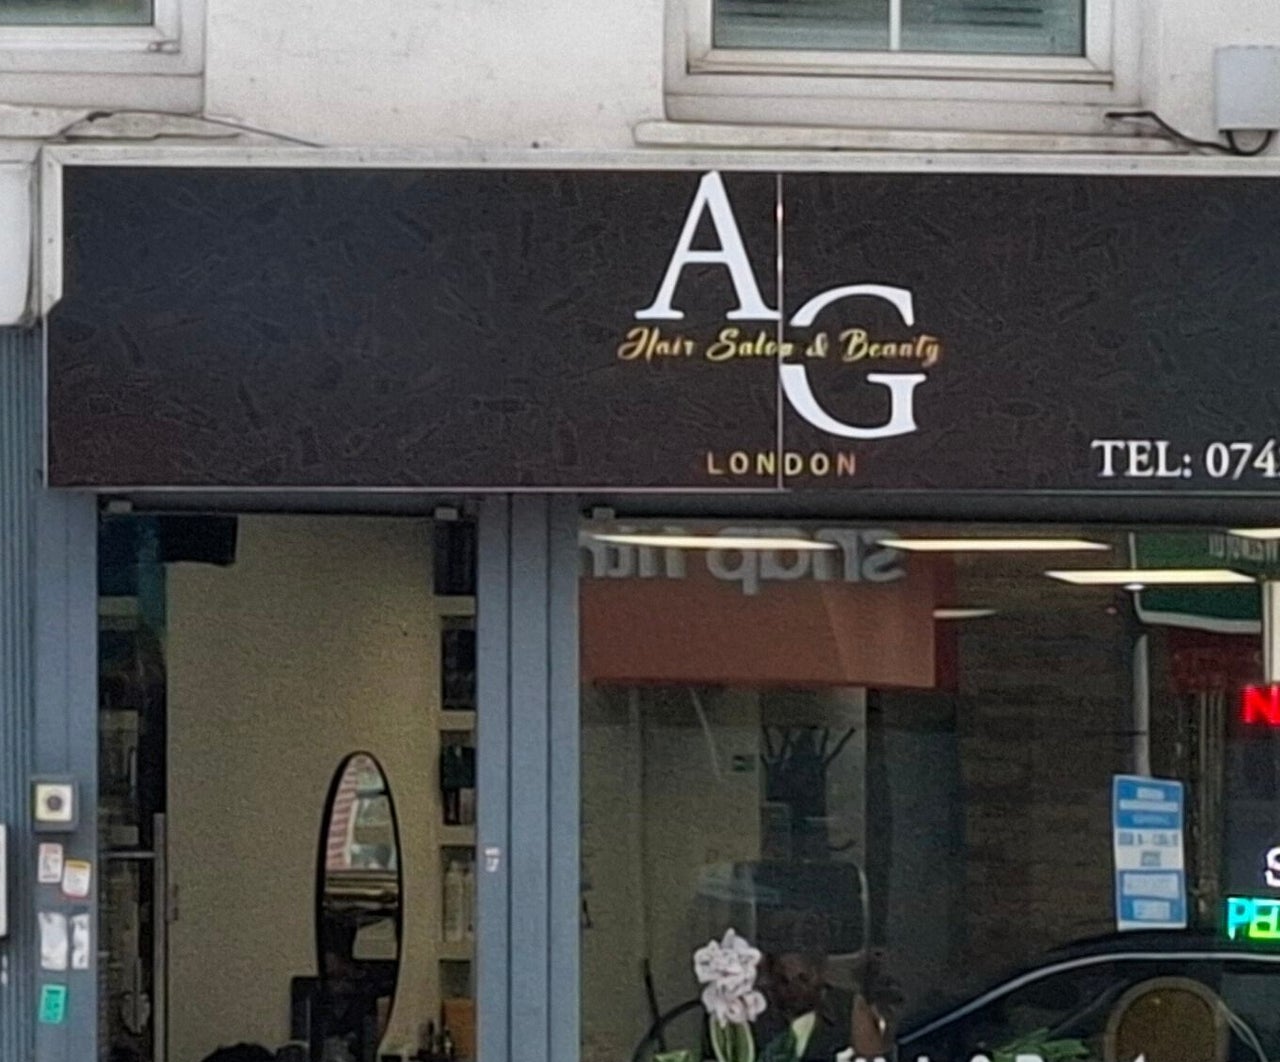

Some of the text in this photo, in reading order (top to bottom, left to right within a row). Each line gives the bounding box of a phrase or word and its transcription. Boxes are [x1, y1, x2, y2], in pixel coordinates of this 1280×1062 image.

[617, 327, 940, 366] Hair Salon & Beauty
[707, 451, 857, 476] LONDON
[1091, 440, 1193, 478] TEL:
